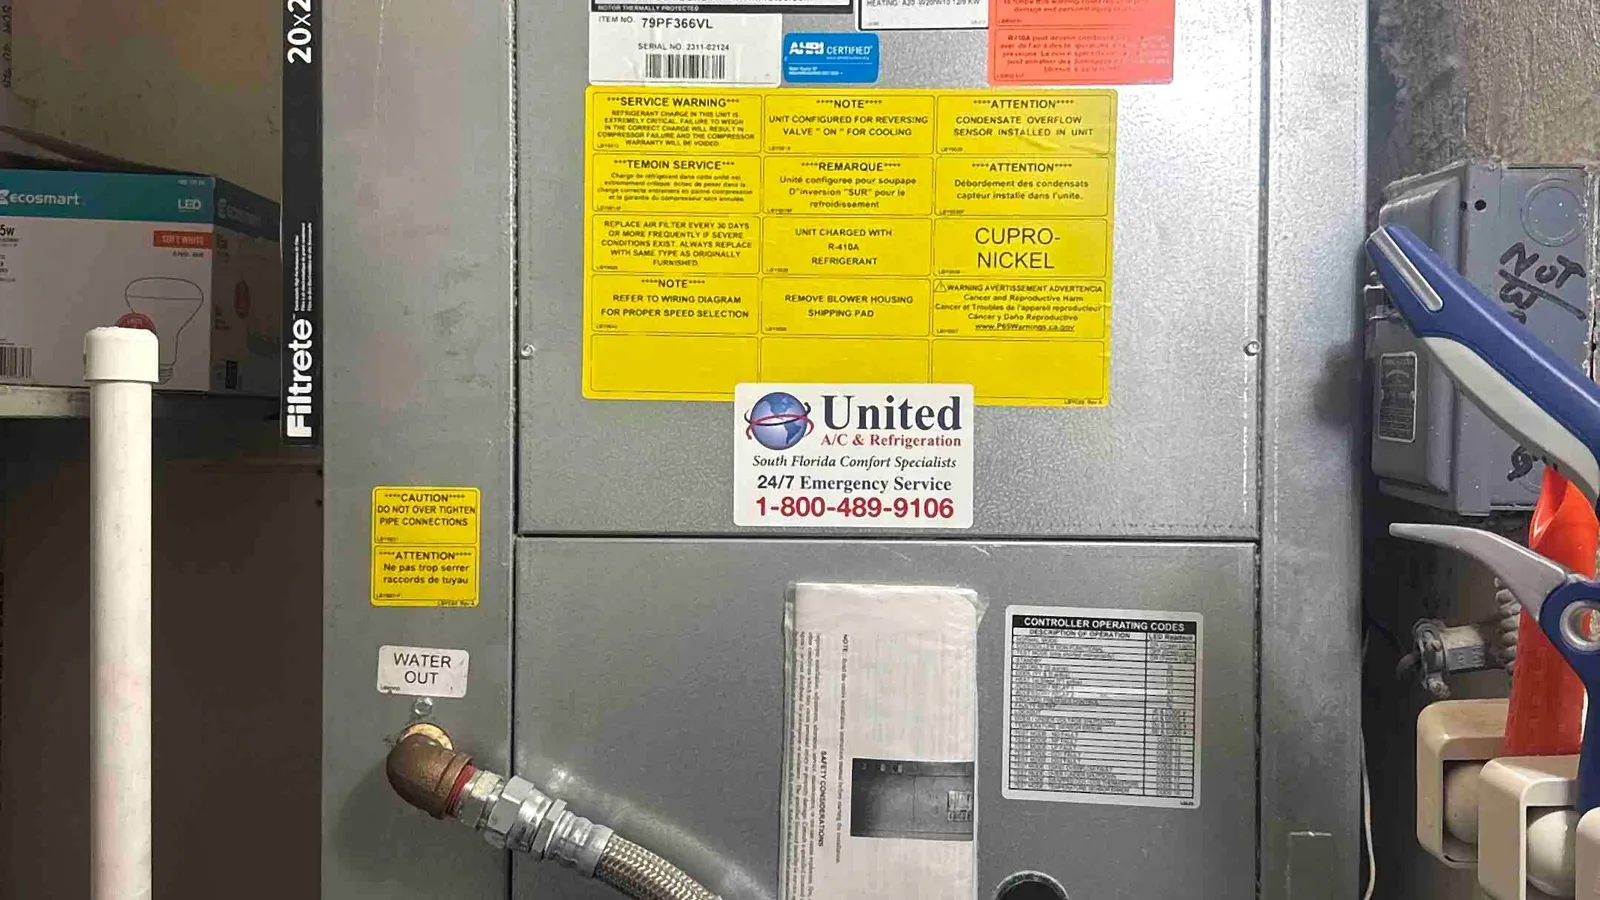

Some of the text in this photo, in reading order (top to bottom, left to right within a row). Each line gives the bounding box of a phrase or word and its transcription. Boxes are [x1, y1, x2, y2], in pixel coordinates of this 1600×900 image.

[599, 15, 618, 23] ITEM
[642, 18, 713, 29] 79PF366VL
[638, 43, 667, 51] SERIAL
[769, 115, 788, 123] UNIT
[876, 116, 928, 124] REVERSING
[956, 116, 1081, 124] CONDENSATE OVERFLOW
[954, 128, 1093, 136] SENSOR INSTALLED IN UNIT
[9, 193, 80, 205] ecosmart
[178, 199, 202, 210] LED
[976, 228, 1060, 245] CUPRO-
[812, 257, 877, 265] REFRIGERANT
[977, 252, 1054, 269] NICKEL
[785, 295, 913, 304] REMOVE BLOWER HOUSING
[1010, 295, 1060, 303] Reproductive
[601, 308, 620, 316] FOR
[664, 309, 694, 317] SPEED
[808, 309, 851, 317] SHIPPING
[287, 318, 313, 438] Filtrete
[821, 394, 962, 431] United
[821, 434, 962, 449] A/C & Refrigeration
[752, 455, 957, 471] South Florida Comfort Specialists
[757, 475, 952, 493] 24/7 Emergency Service
[392, 506, 409, 514] NOT
[412, 506, 436, 514] OVER
[439, 506, 475, 514] TIGHTEN
[756, 496, 955, 519] 1-800-489-9106
[380, 517, 468, 526] PIPE CONNECTIONS
[384, 564, 396, 572] Ne
[399, 565, 416, 573] pas
[419, 565, 439, 573] trop
[383, 576, 468, 586] raccords de tuyau
[1024, 618, 1184, 631] CONTROLLER OPERATING CODES
[394, 653, 451, 668] WATER
[404, 671, 438, 684] OUT
[820, 751, 828, 780] SAFETY
